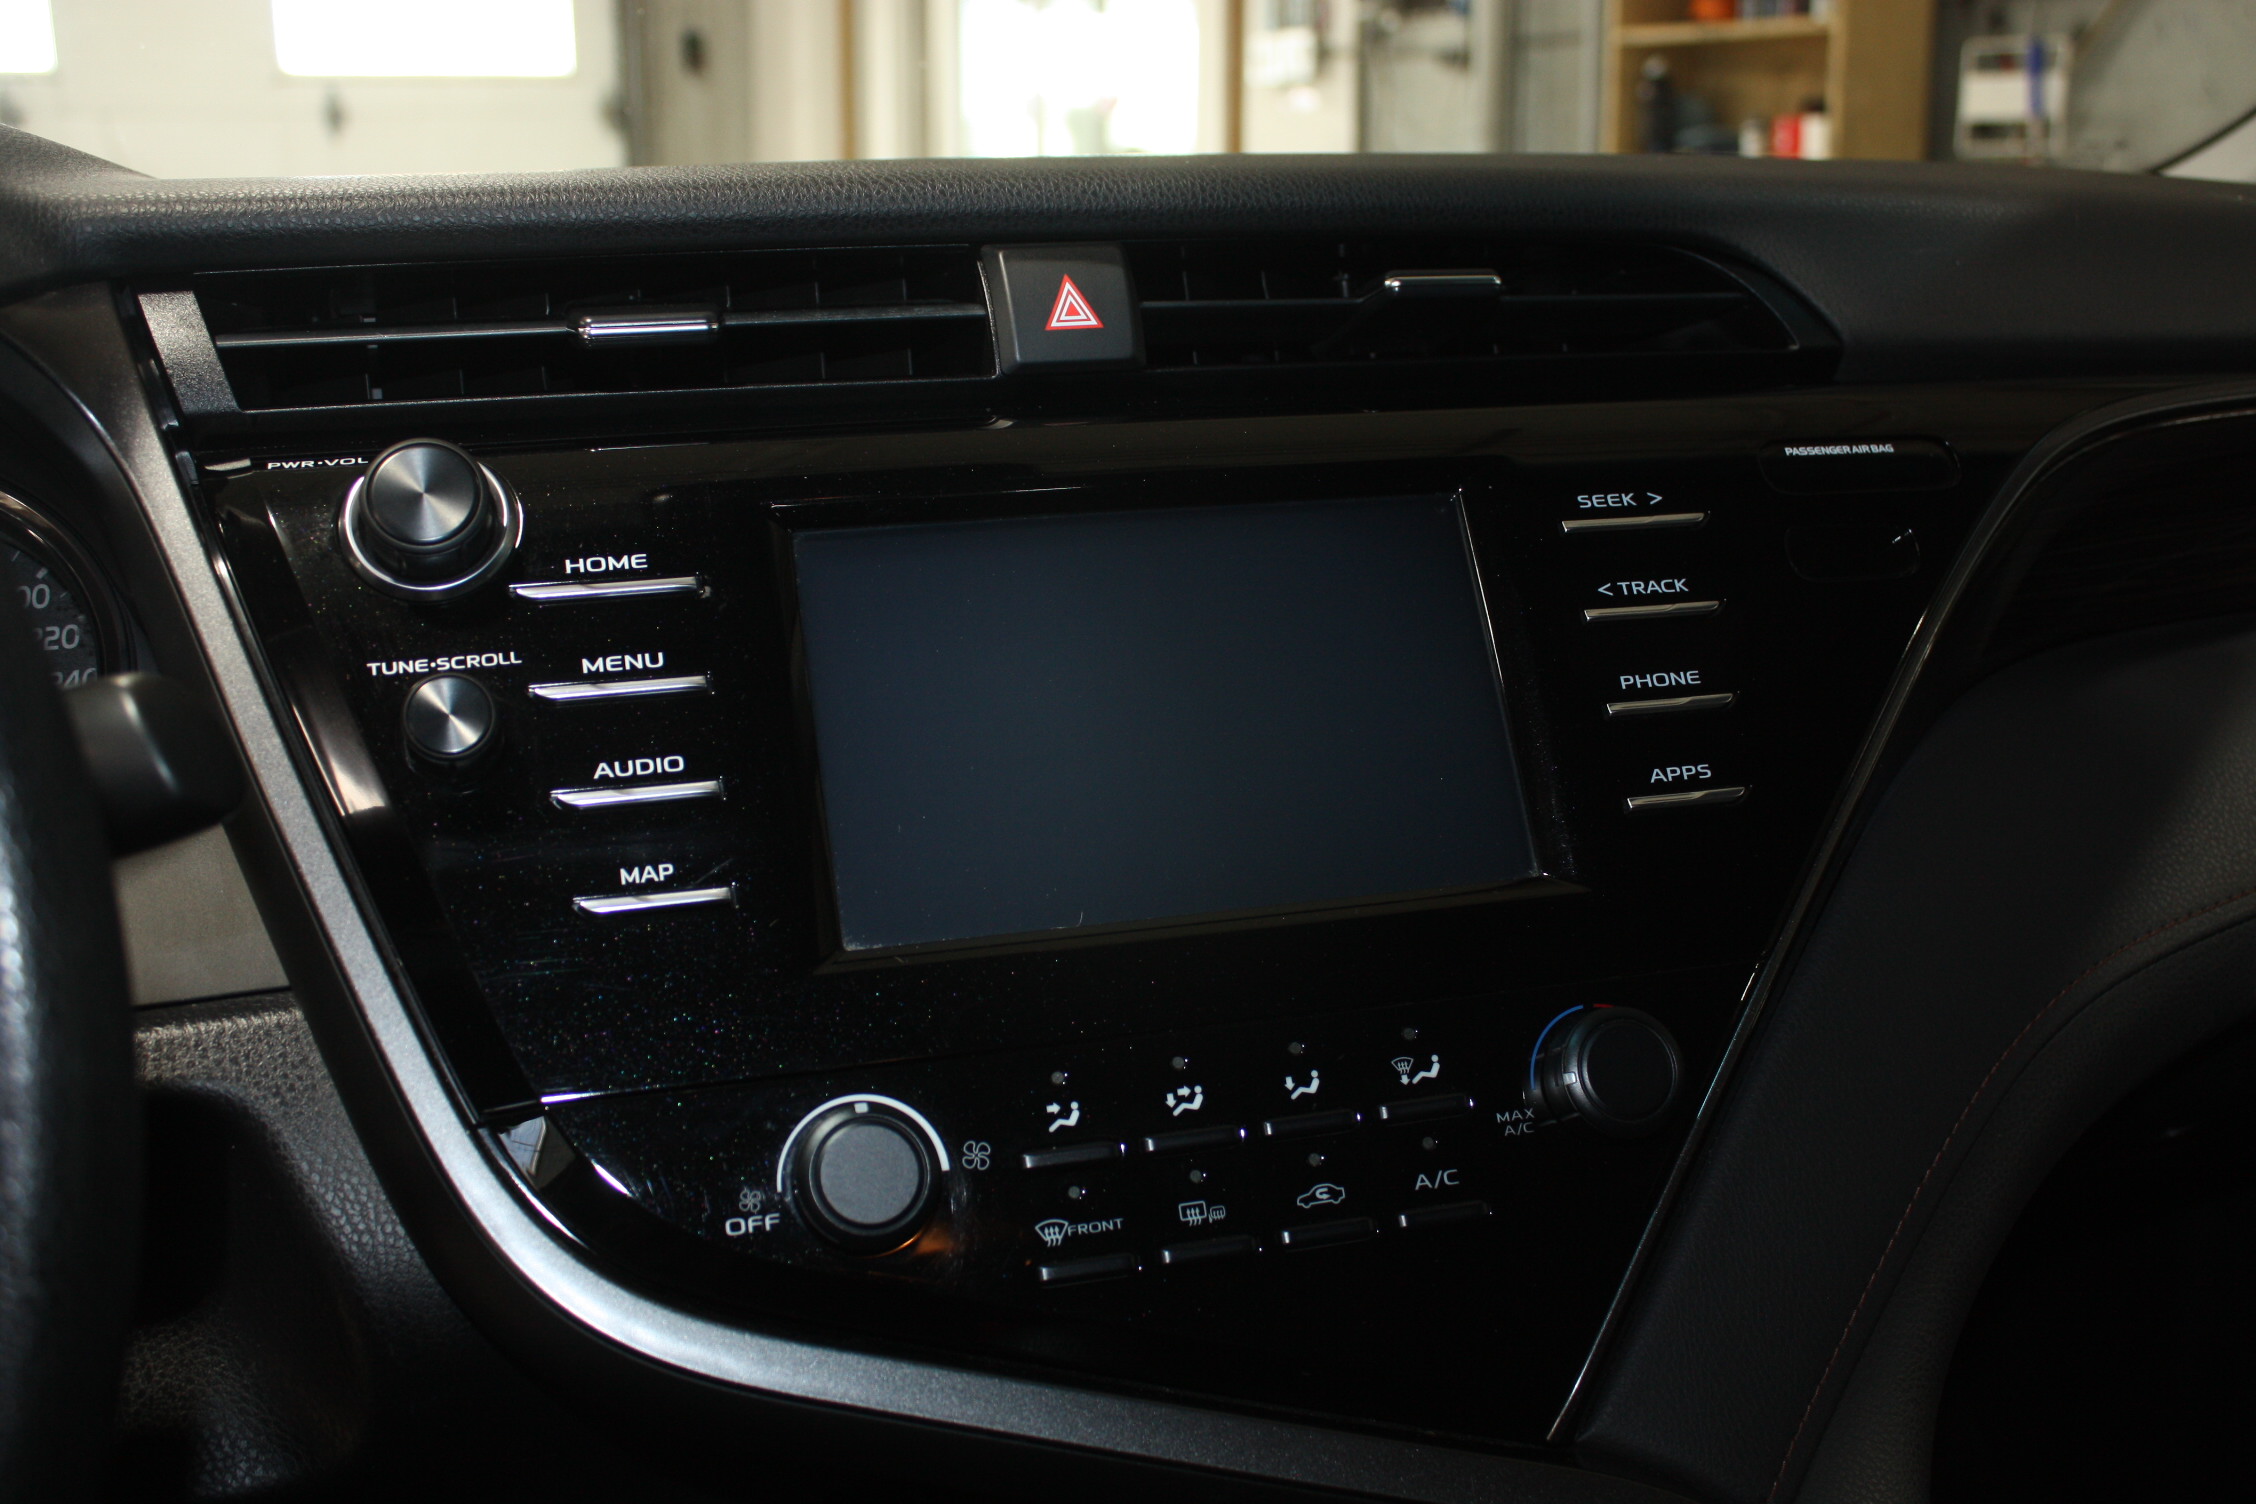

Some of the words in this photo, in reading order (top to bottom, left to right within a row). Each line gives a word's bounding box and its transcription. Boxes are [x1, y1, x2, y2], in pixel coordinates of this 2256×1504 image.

[1784, 444, 1852, 456] PASSENGER
[1852, 444, 1871, 454] AIR
[1870, 443, 1894, 453] BAG
[1577, 492, 1638, 509] SEEK
[564, 553, 648, 574] HOME
[1616, 578, 1689, 596] TRACK
[581, 652, 665, 674] MENU
[1619, 670, 1702, 690] PHONE
[592, 755, 686, 780] AUDIO
[1650, 763, 1712, 783] APPS
[619, 863, 675, 886] MAP
[1496, 1107, 1535, 1124] MAX
[1504, 1121, 1536, 1137] A/C
[1414, 1168, 1461, 1191] A/C
[724, 1212, 781, 1237] OFF
[1067, 1217, 1125, 1237] FRONT
